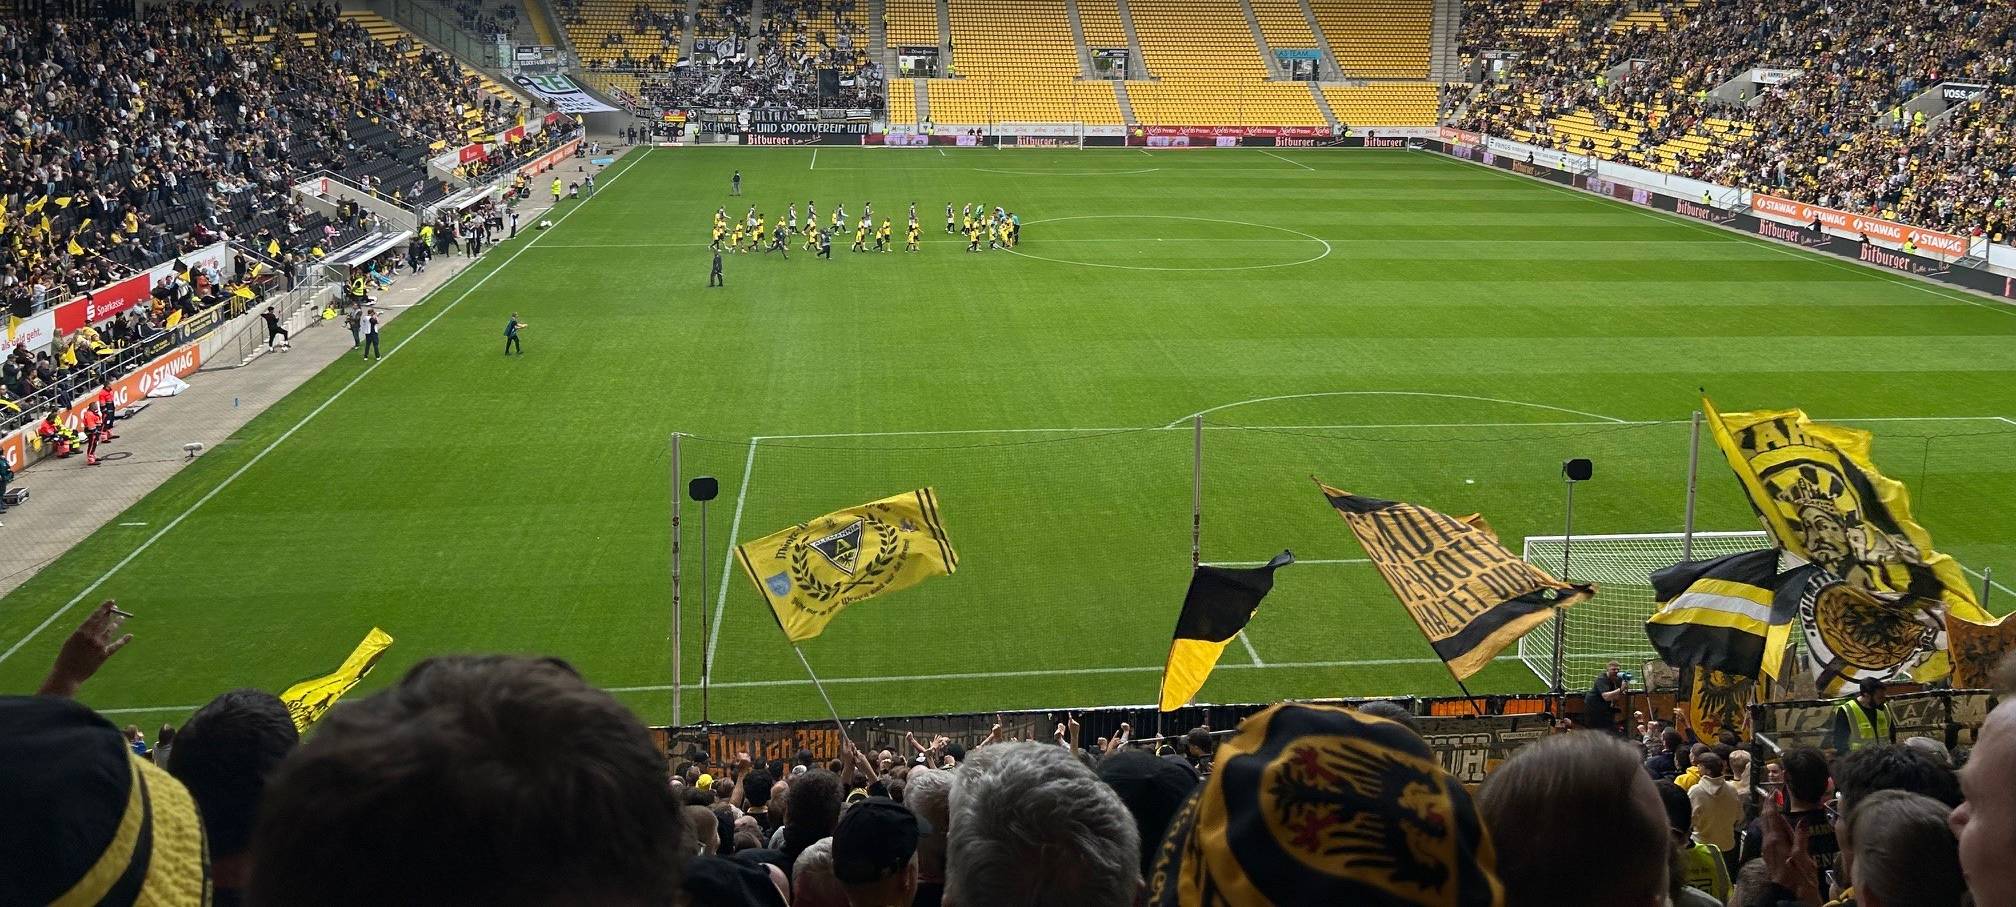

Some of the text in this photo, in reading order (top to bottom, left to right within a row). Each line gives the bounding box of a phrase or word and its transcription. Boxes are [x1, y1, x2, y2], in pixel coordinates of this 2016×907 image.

[754, 110, 795, 122] ULTRAS
[780, 122, 844, 134] SPORTVEREIN
[847, 122, 868, 134] ULM
[748, 134, 790, 145] Bitburger
[1275, 136, 1314, 147] Bitburger
[1364, 136, 1403, 147] Bitburger
[1676, 199, 1710, 220] Bitburger
[1766, 201, 1797, 215] STAWAG
[1812, 209, 1846, 226] STAWAG
[1758, 218, 1799, 242] Bitburger
[1864, 222, 1901, 239] STAWAG
[1921, 235, 1962, 253] STAWAG
[1860, 242, 1910, 271] Bitburger
[96, 297, 125, 317] Sparkasse
[1, 338, 10, 351] als
[25, 327, 42, 344] geht.
[152, 351, 193, 387] STAWAG
[814, 523, 860, 547] ALEMANNIA
[835, 538, 853, 553] A
[1477, 562, 1538, 600] DUR
[1412, 584, 1488, 638] HALTET
